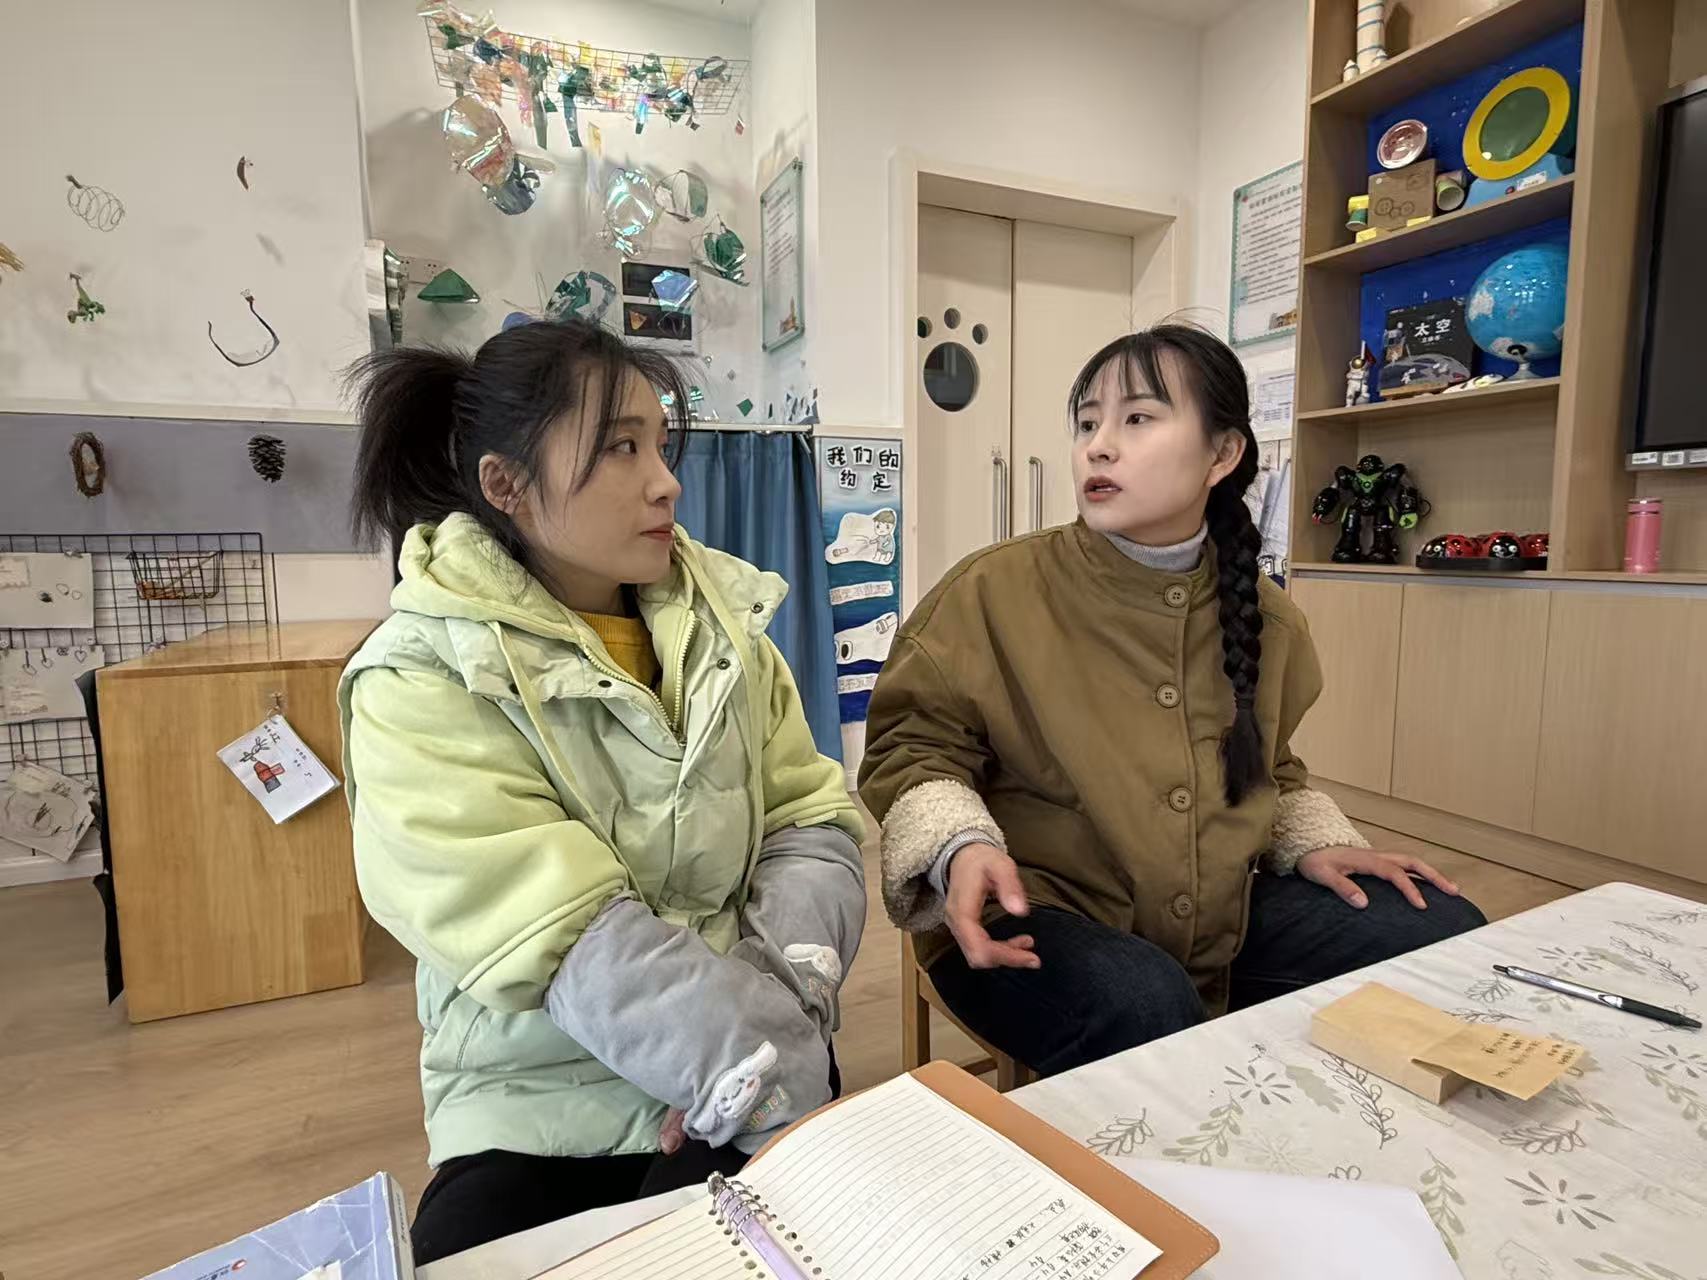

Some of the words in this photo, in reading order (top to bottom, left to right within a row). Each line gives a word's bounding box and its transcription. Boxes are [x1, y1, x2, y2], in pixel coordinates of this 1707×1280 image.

[1414, 319, 1451, 337] 太空
[827, 446, 899, 468] 我们的
[840, 469, 892, 491] 约定
